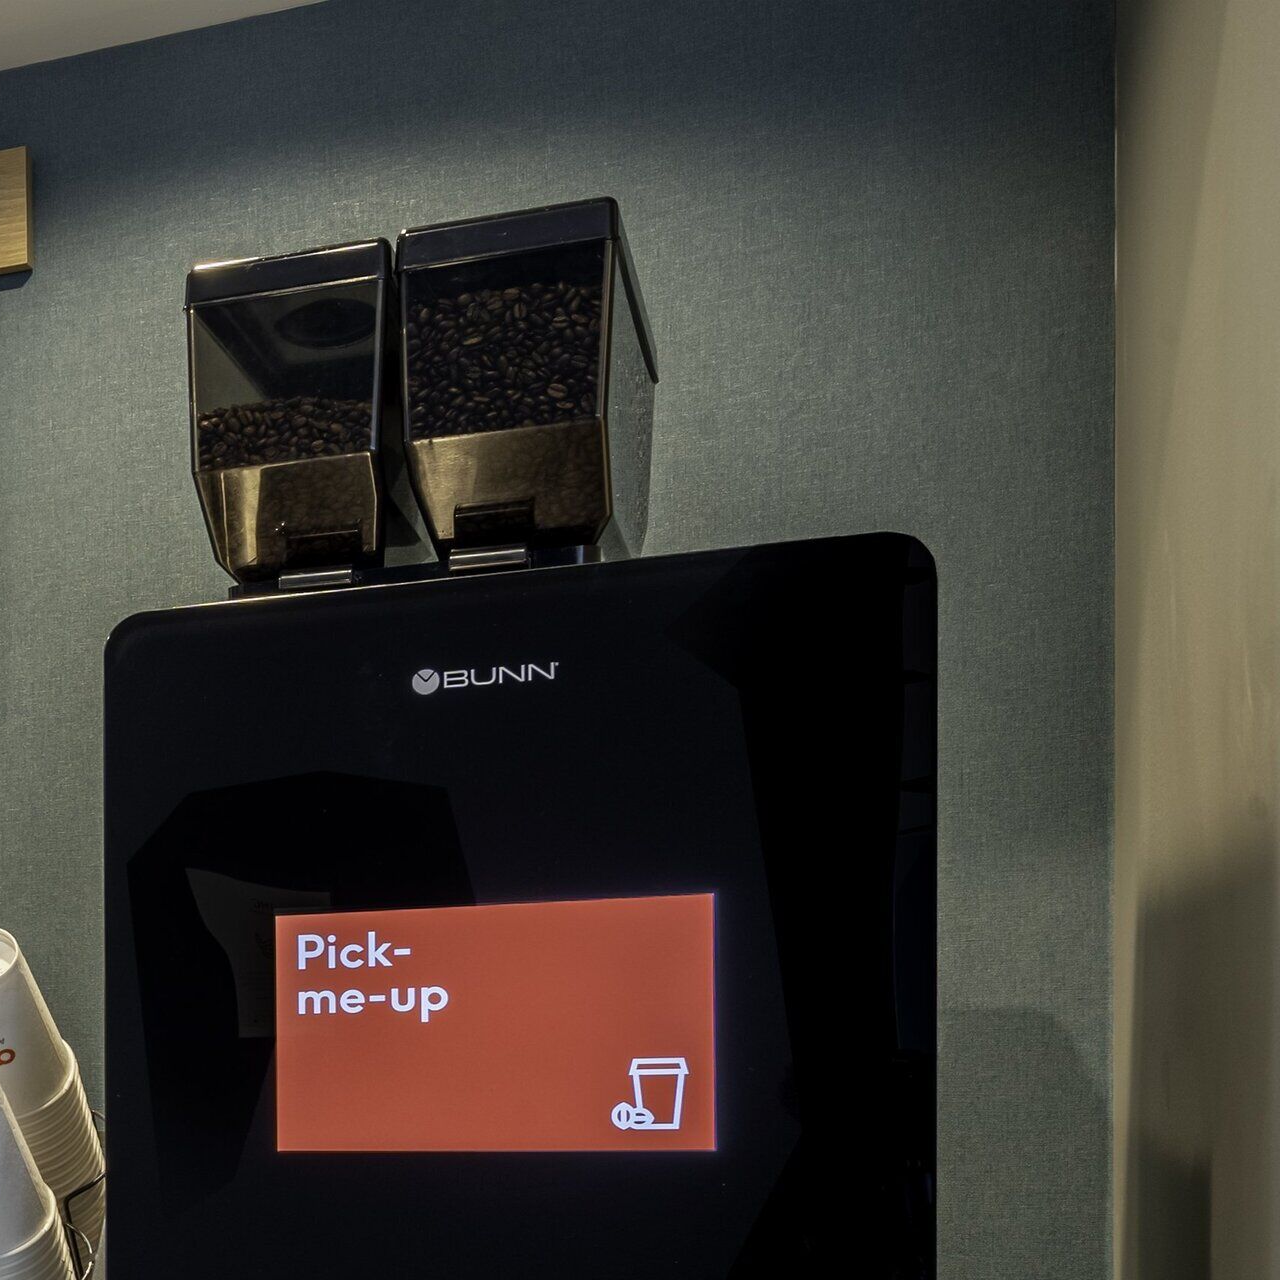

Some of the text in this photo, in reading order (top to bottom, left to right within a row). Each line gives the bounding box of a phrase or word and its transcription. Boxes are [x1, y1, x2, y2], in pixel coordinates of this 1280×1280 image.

[443, 663, 557, 689] BUNN
[297, 931, 412, 970] Pick-
[297, 983, 449, 1023] me-up
